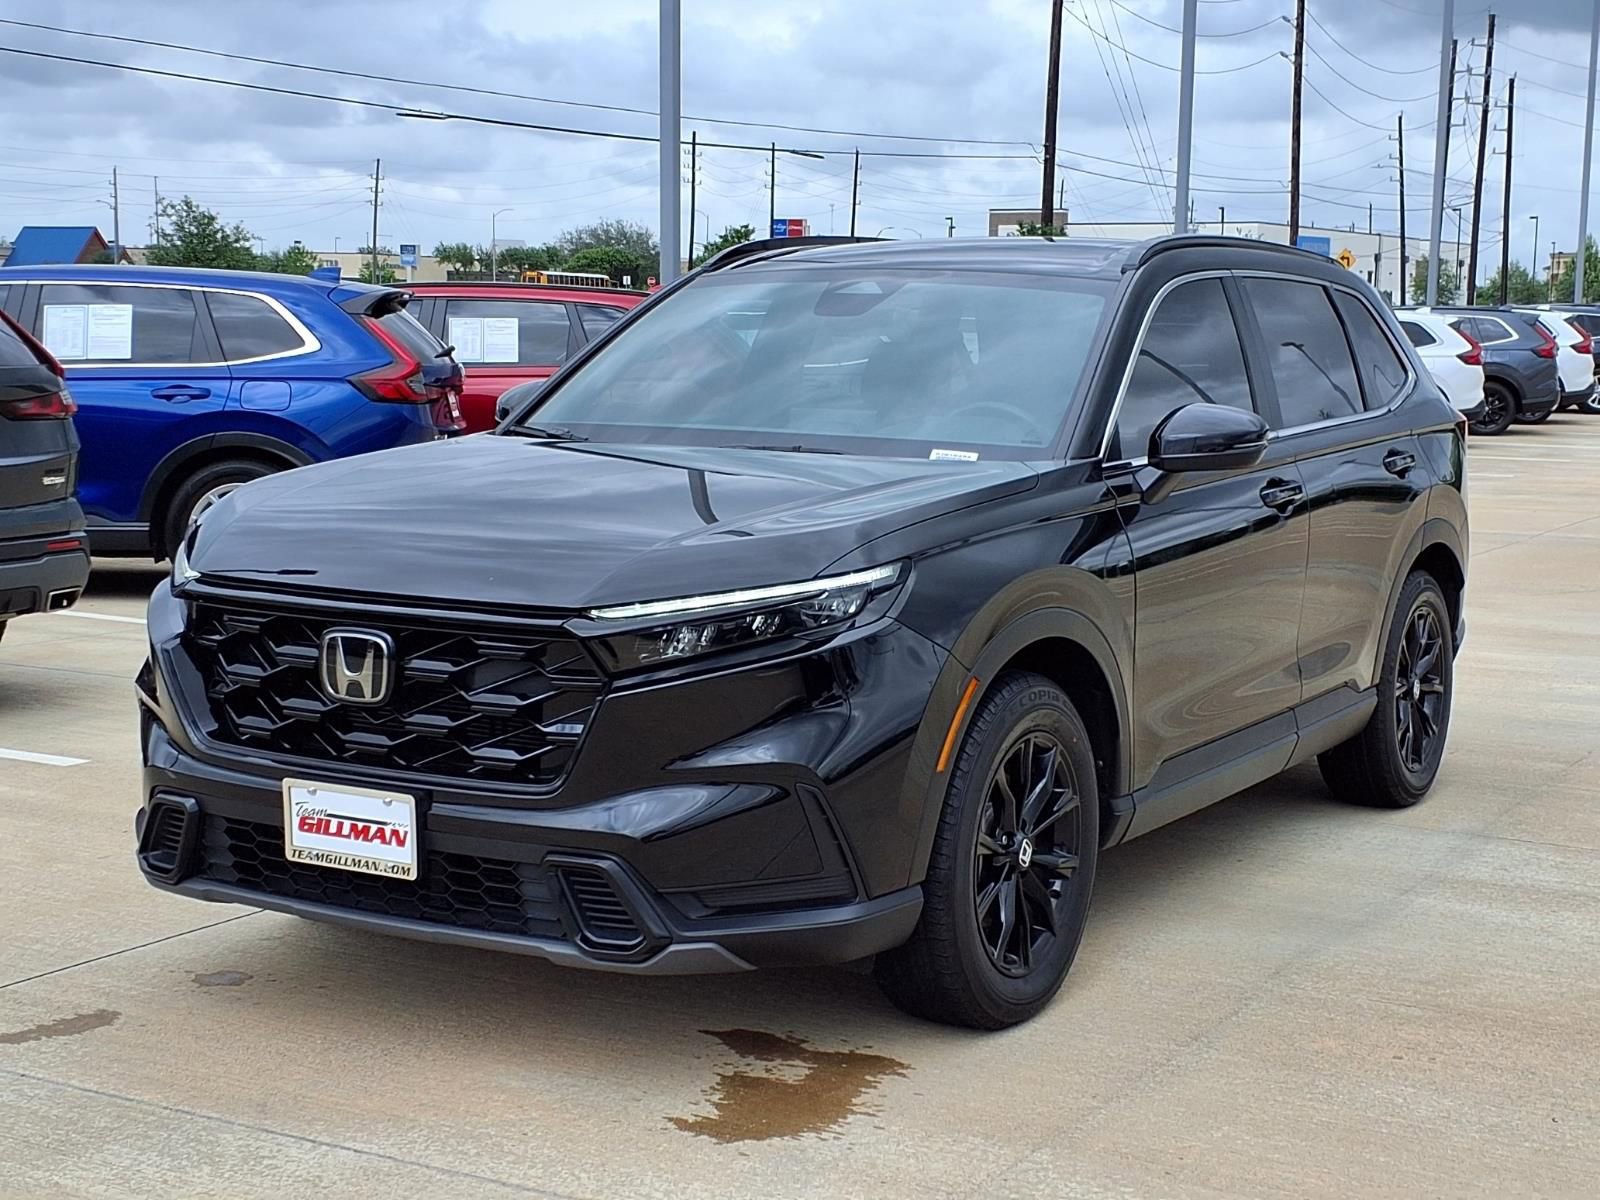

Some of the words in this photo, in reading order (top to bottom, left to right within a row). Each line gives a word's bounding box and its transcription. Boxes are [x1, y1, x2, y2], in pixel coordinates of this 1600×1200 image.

[295, 801, 328, 817] Team
[298, 815, 409, 848] GILLMAN
[291, 848, 412, 877] TEAMGILLMAN.COM
